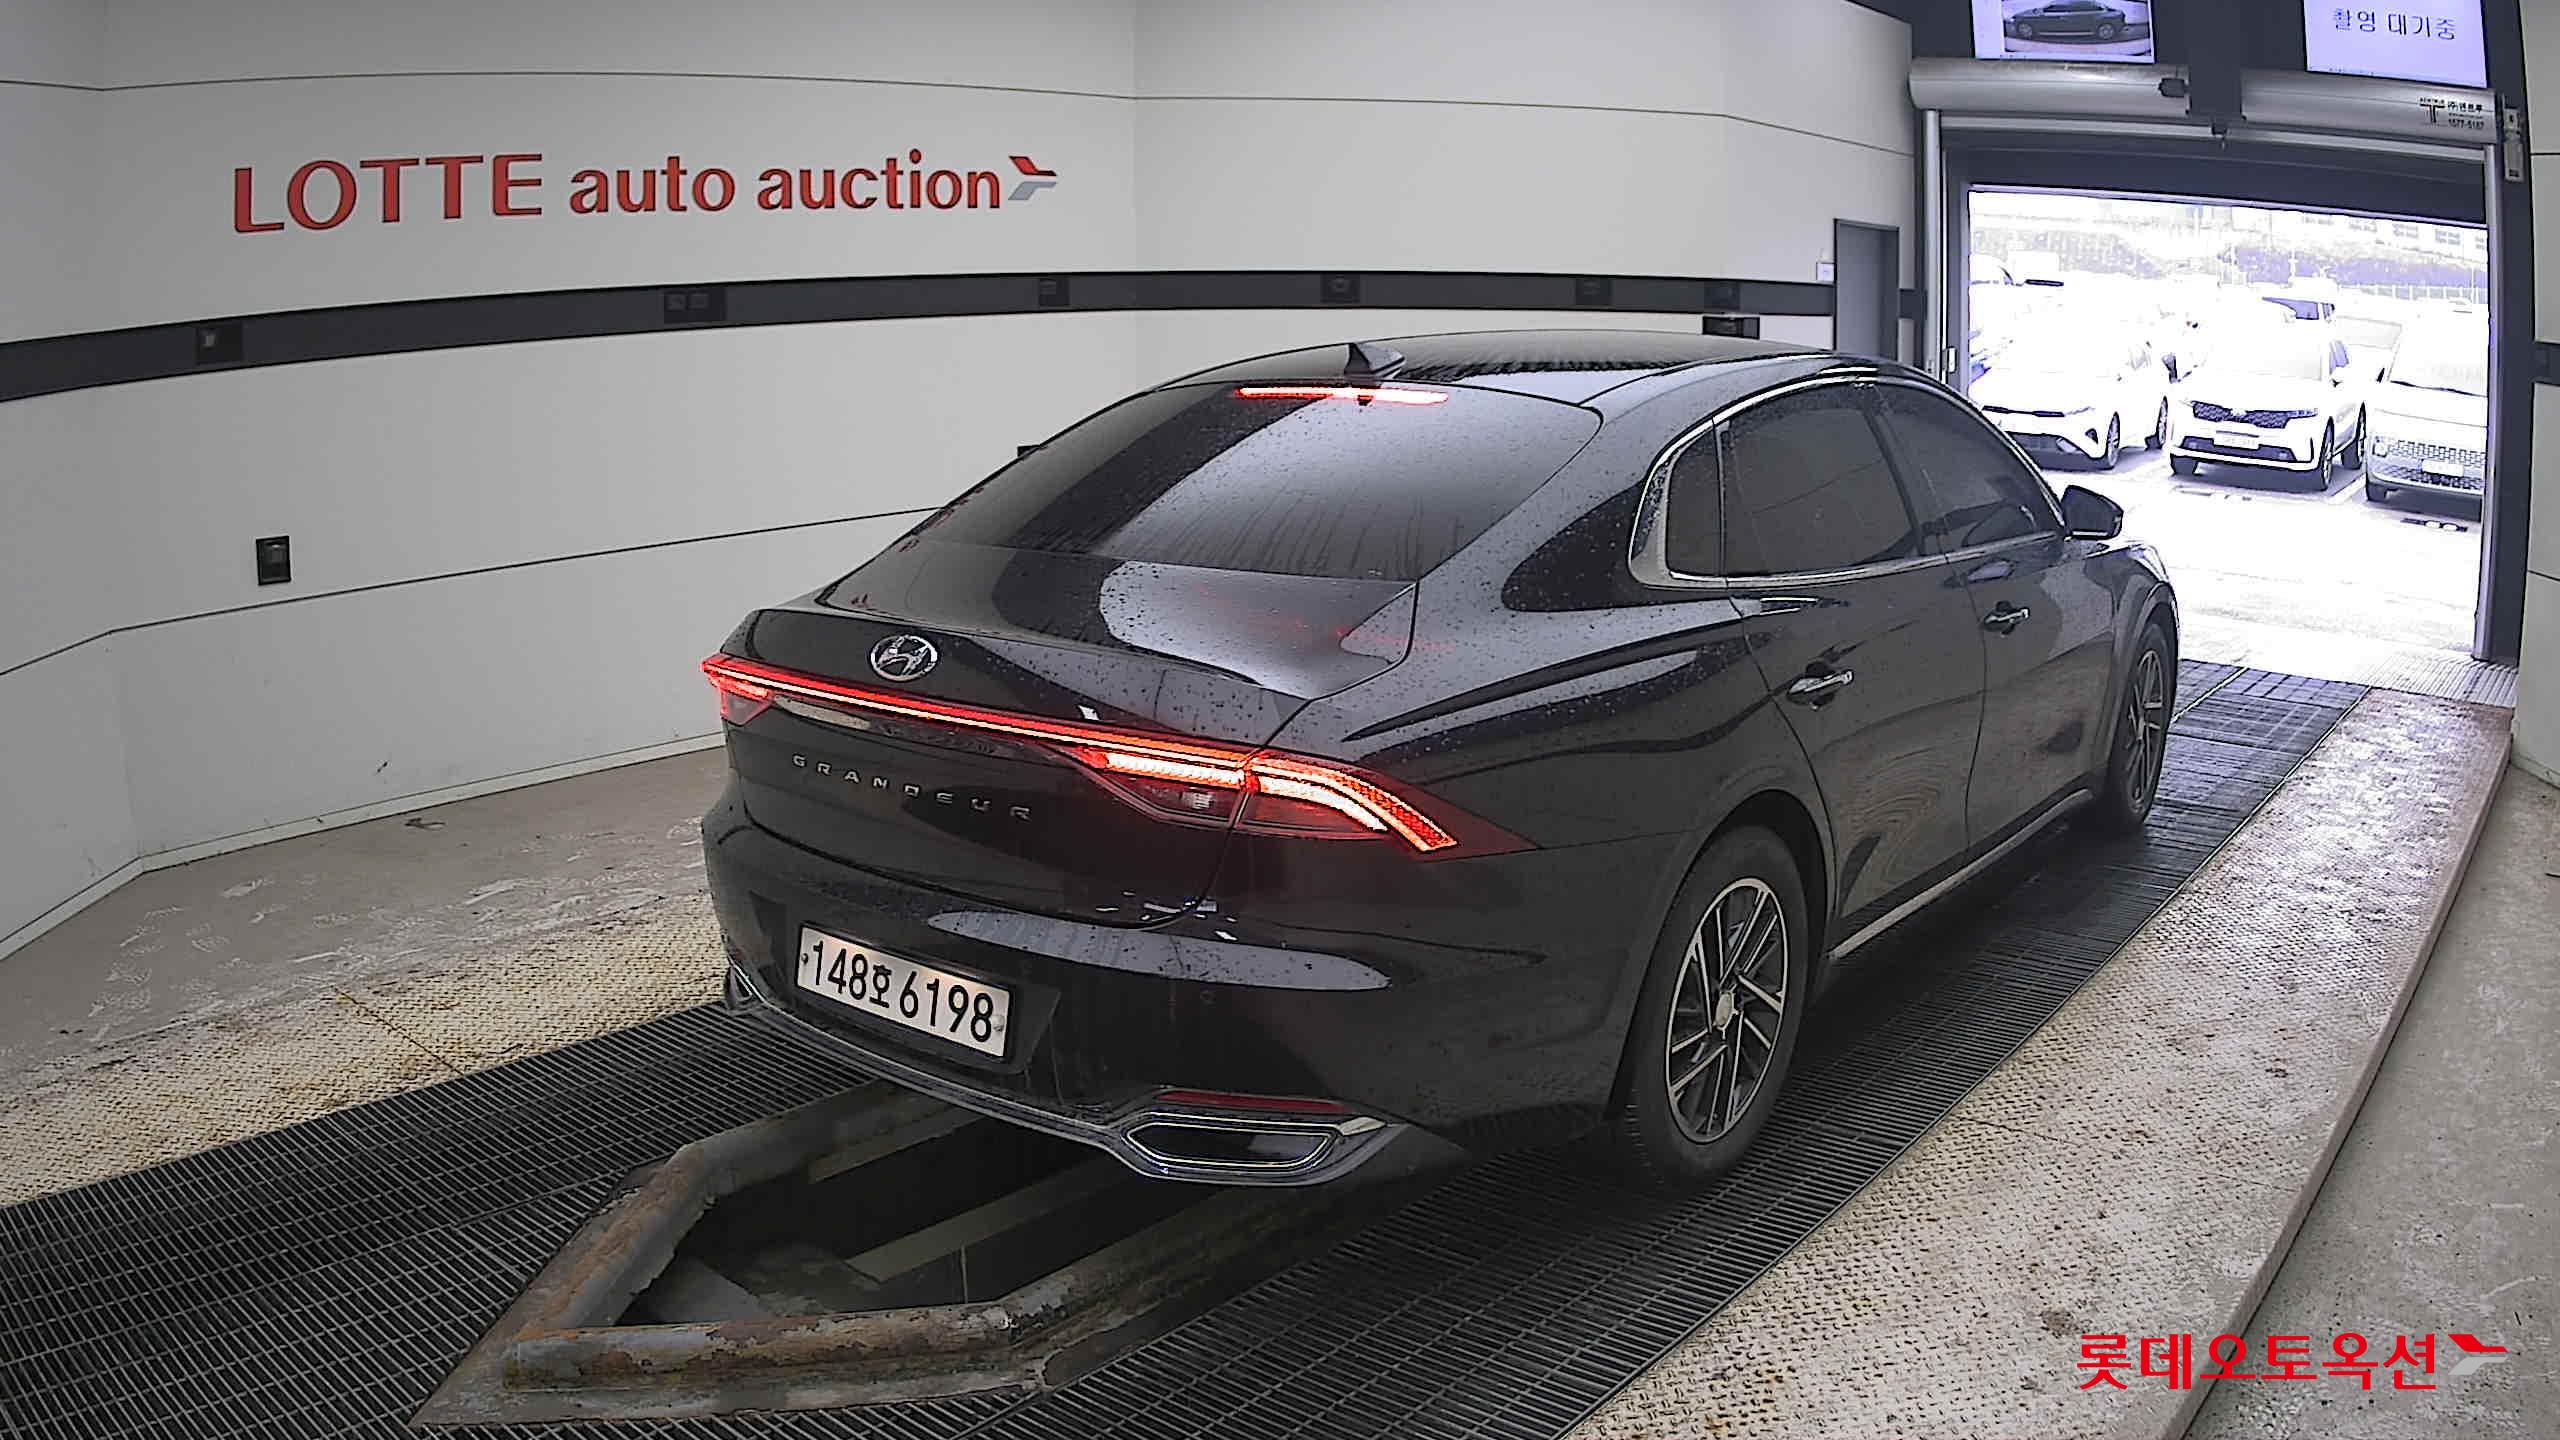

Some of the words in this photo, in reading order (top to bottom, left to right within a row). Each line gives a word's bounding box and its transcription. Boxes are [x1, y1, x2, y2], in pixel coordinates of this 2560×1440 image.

[2334, 7, 2376, 33] 촬영
[2387, 13, 2455, 40] 대기중
[234, 152, 543, 233] LOTTE
[569, 154, 736, 214] auto
[757, 147, 1001, 210] auction
[792, 754, 1031, 821] GRANDEUR
[812, 940, 892, 1009] 148호
[899, 970, 994, 1043] 6198
